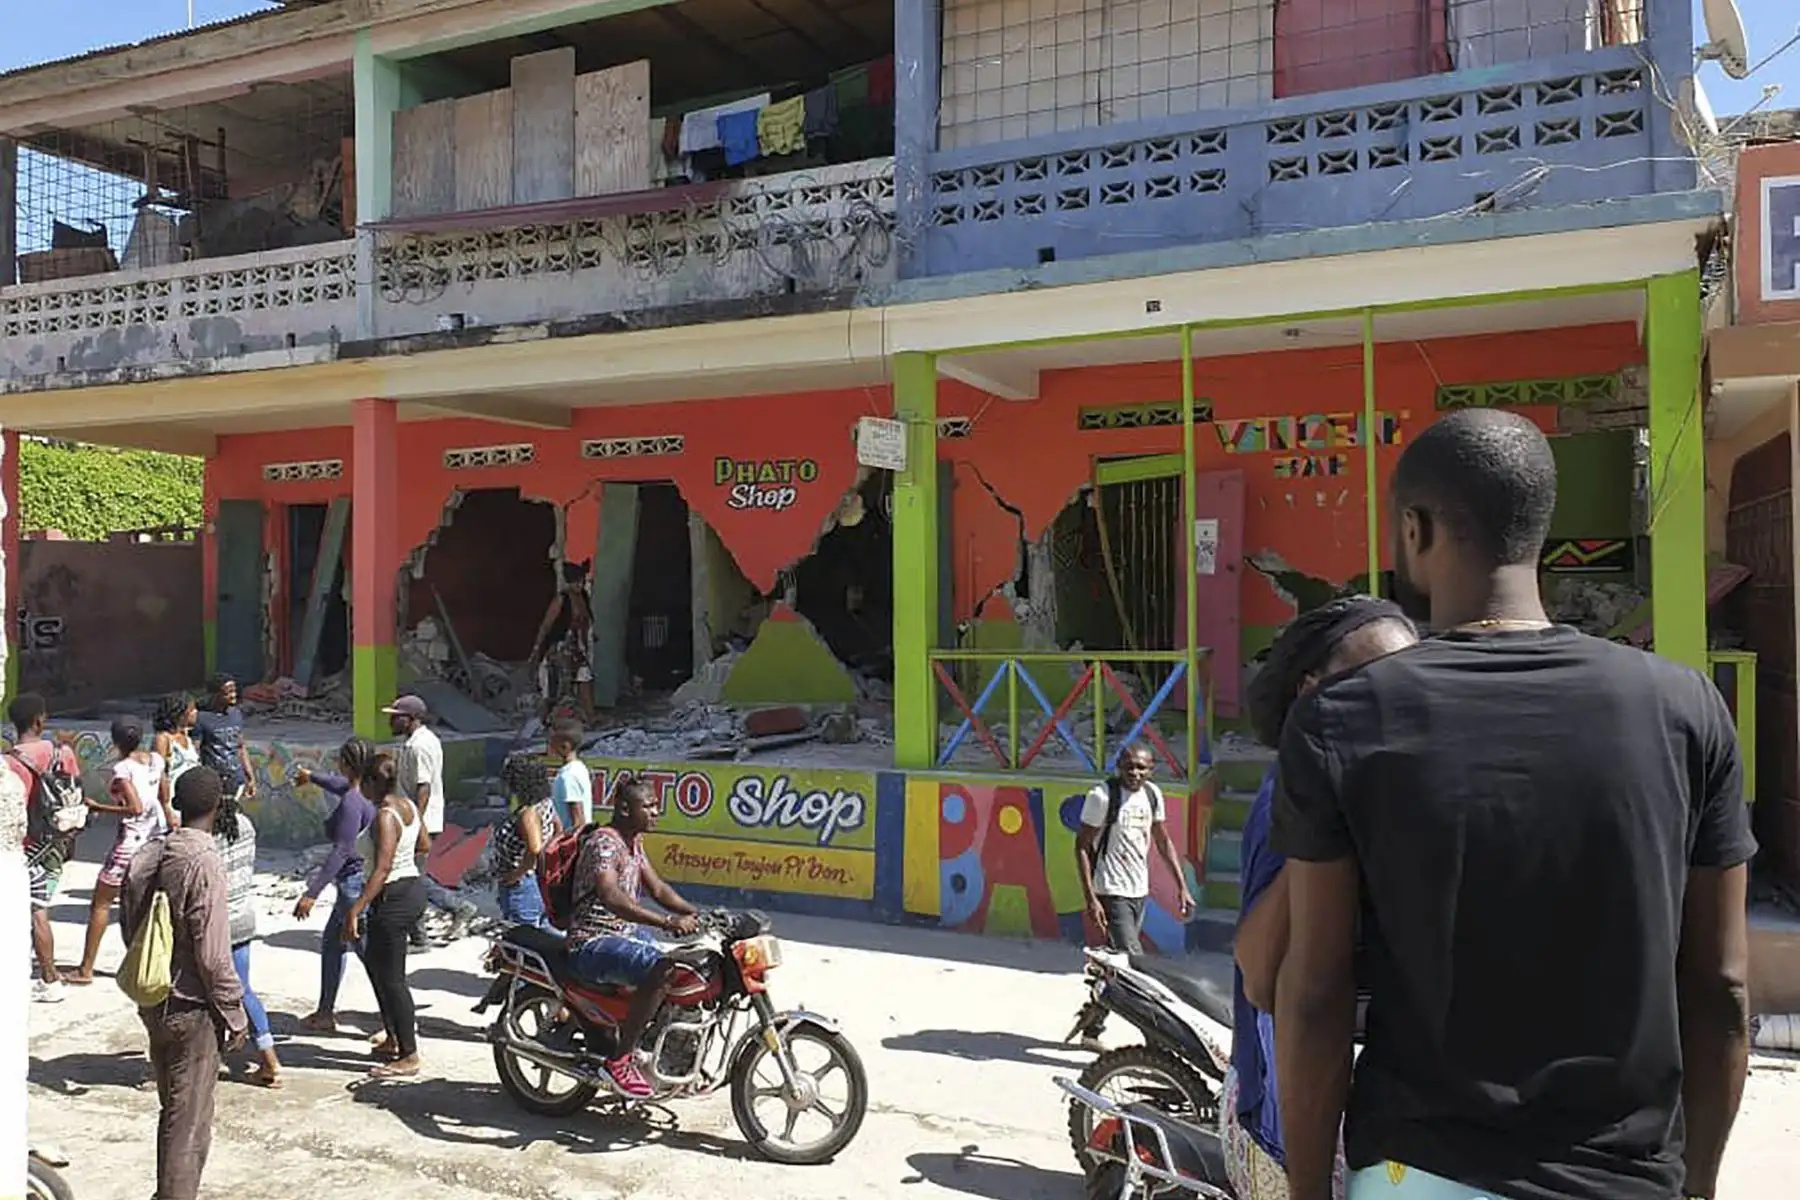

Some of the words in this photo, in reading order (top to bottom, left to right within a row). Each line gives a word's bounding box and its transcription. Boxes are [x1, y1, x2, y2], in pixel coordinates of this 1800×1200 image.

[715, 457, 818, 485] PHATO
[727, 483, 797, 511] Shop
[728, 775, 866, 848] Shop
